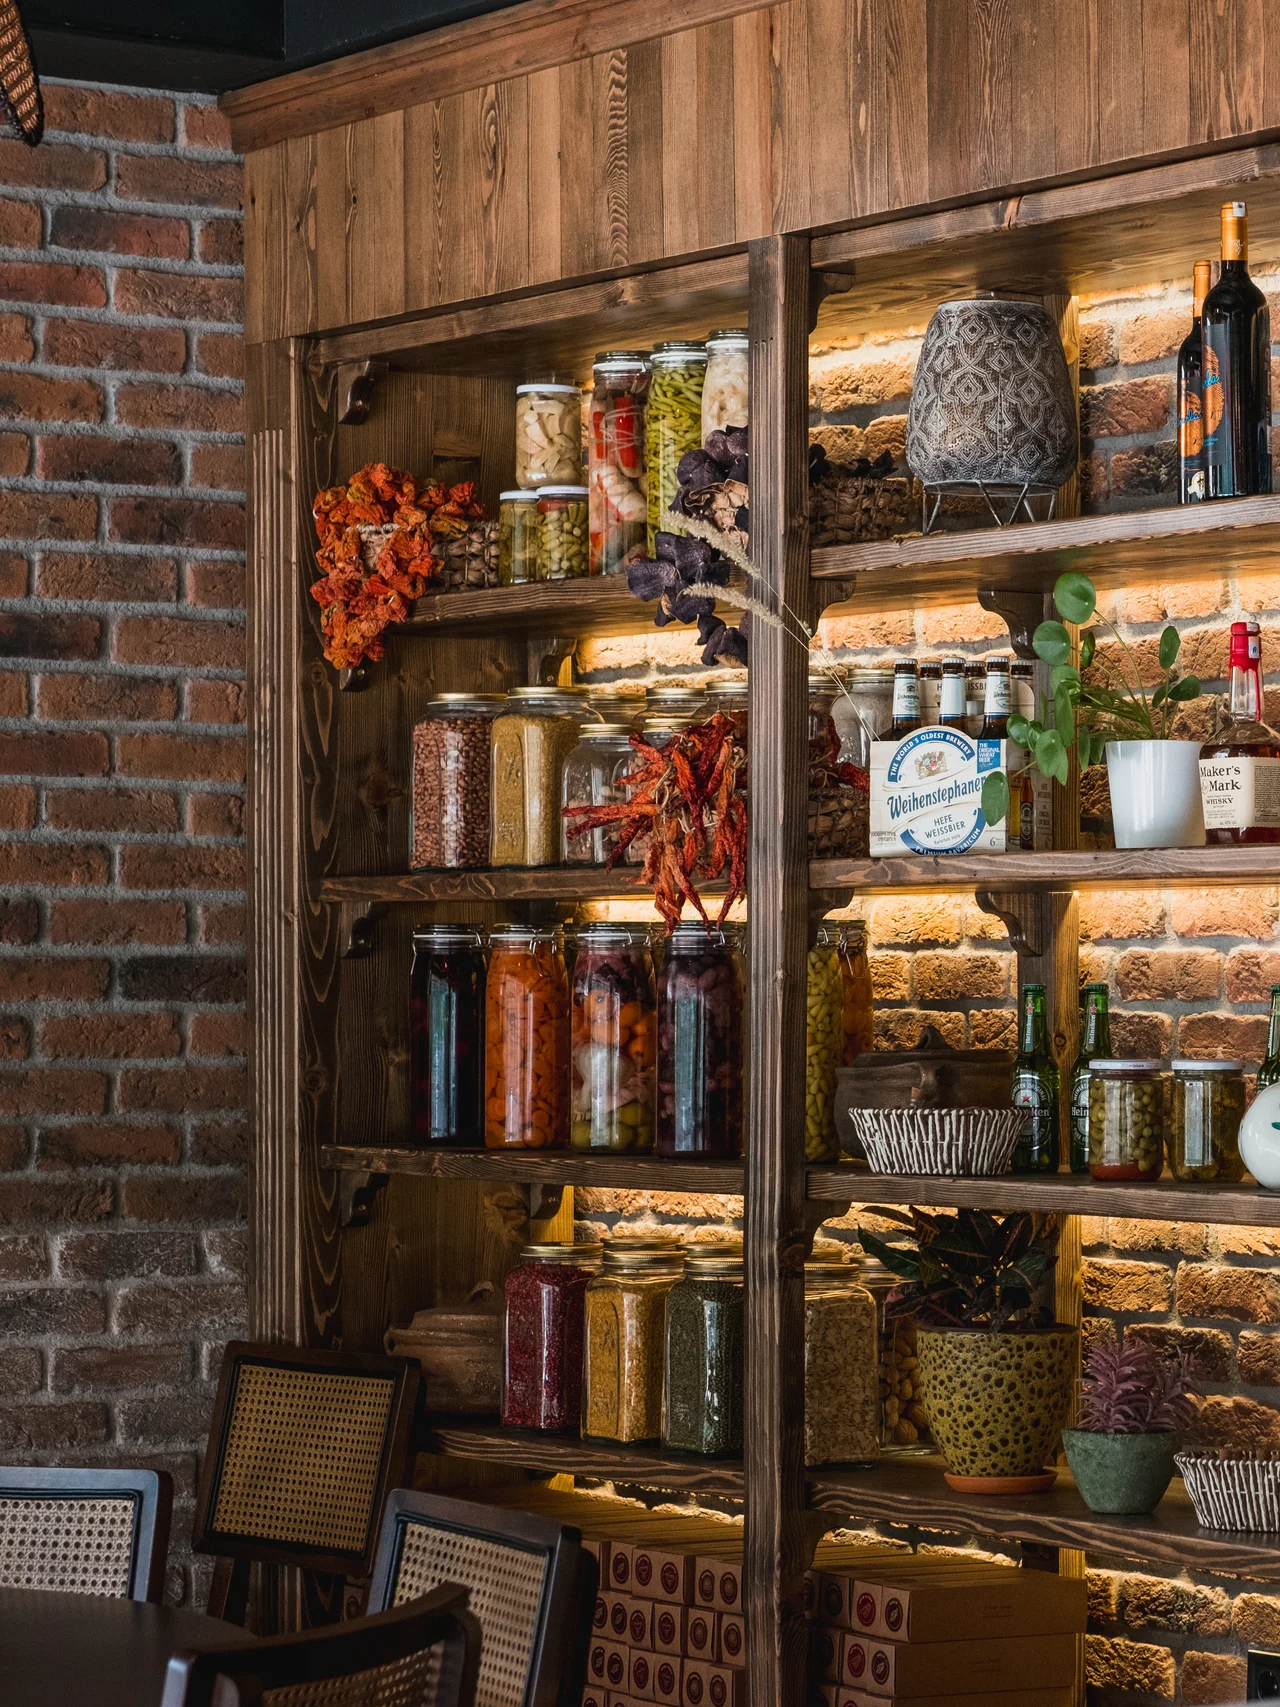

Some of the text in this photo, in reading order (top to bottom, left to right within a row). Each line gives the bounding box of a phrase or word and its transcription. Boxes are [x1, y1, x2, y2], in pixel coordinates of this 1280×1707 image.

[890, 732, 972, 777] THE WORLD'S OLDEST BREWERY
[1200, 765, 1241, 778] Maker's
[1209, 779, 1242, 792] Mark
[1206, 797, 1234, 805] WHISKY
[933, 813, 953, 827] HEFE
[924, 820, 966, 839] WEISSBIER
[989, 836, 996, 847] 6
[1025, 1014, 1033, 1044] Heineken
[1088, 1014, 1096, 1044] Heineken
[1071, 1106, 1089, 1117] Hein
